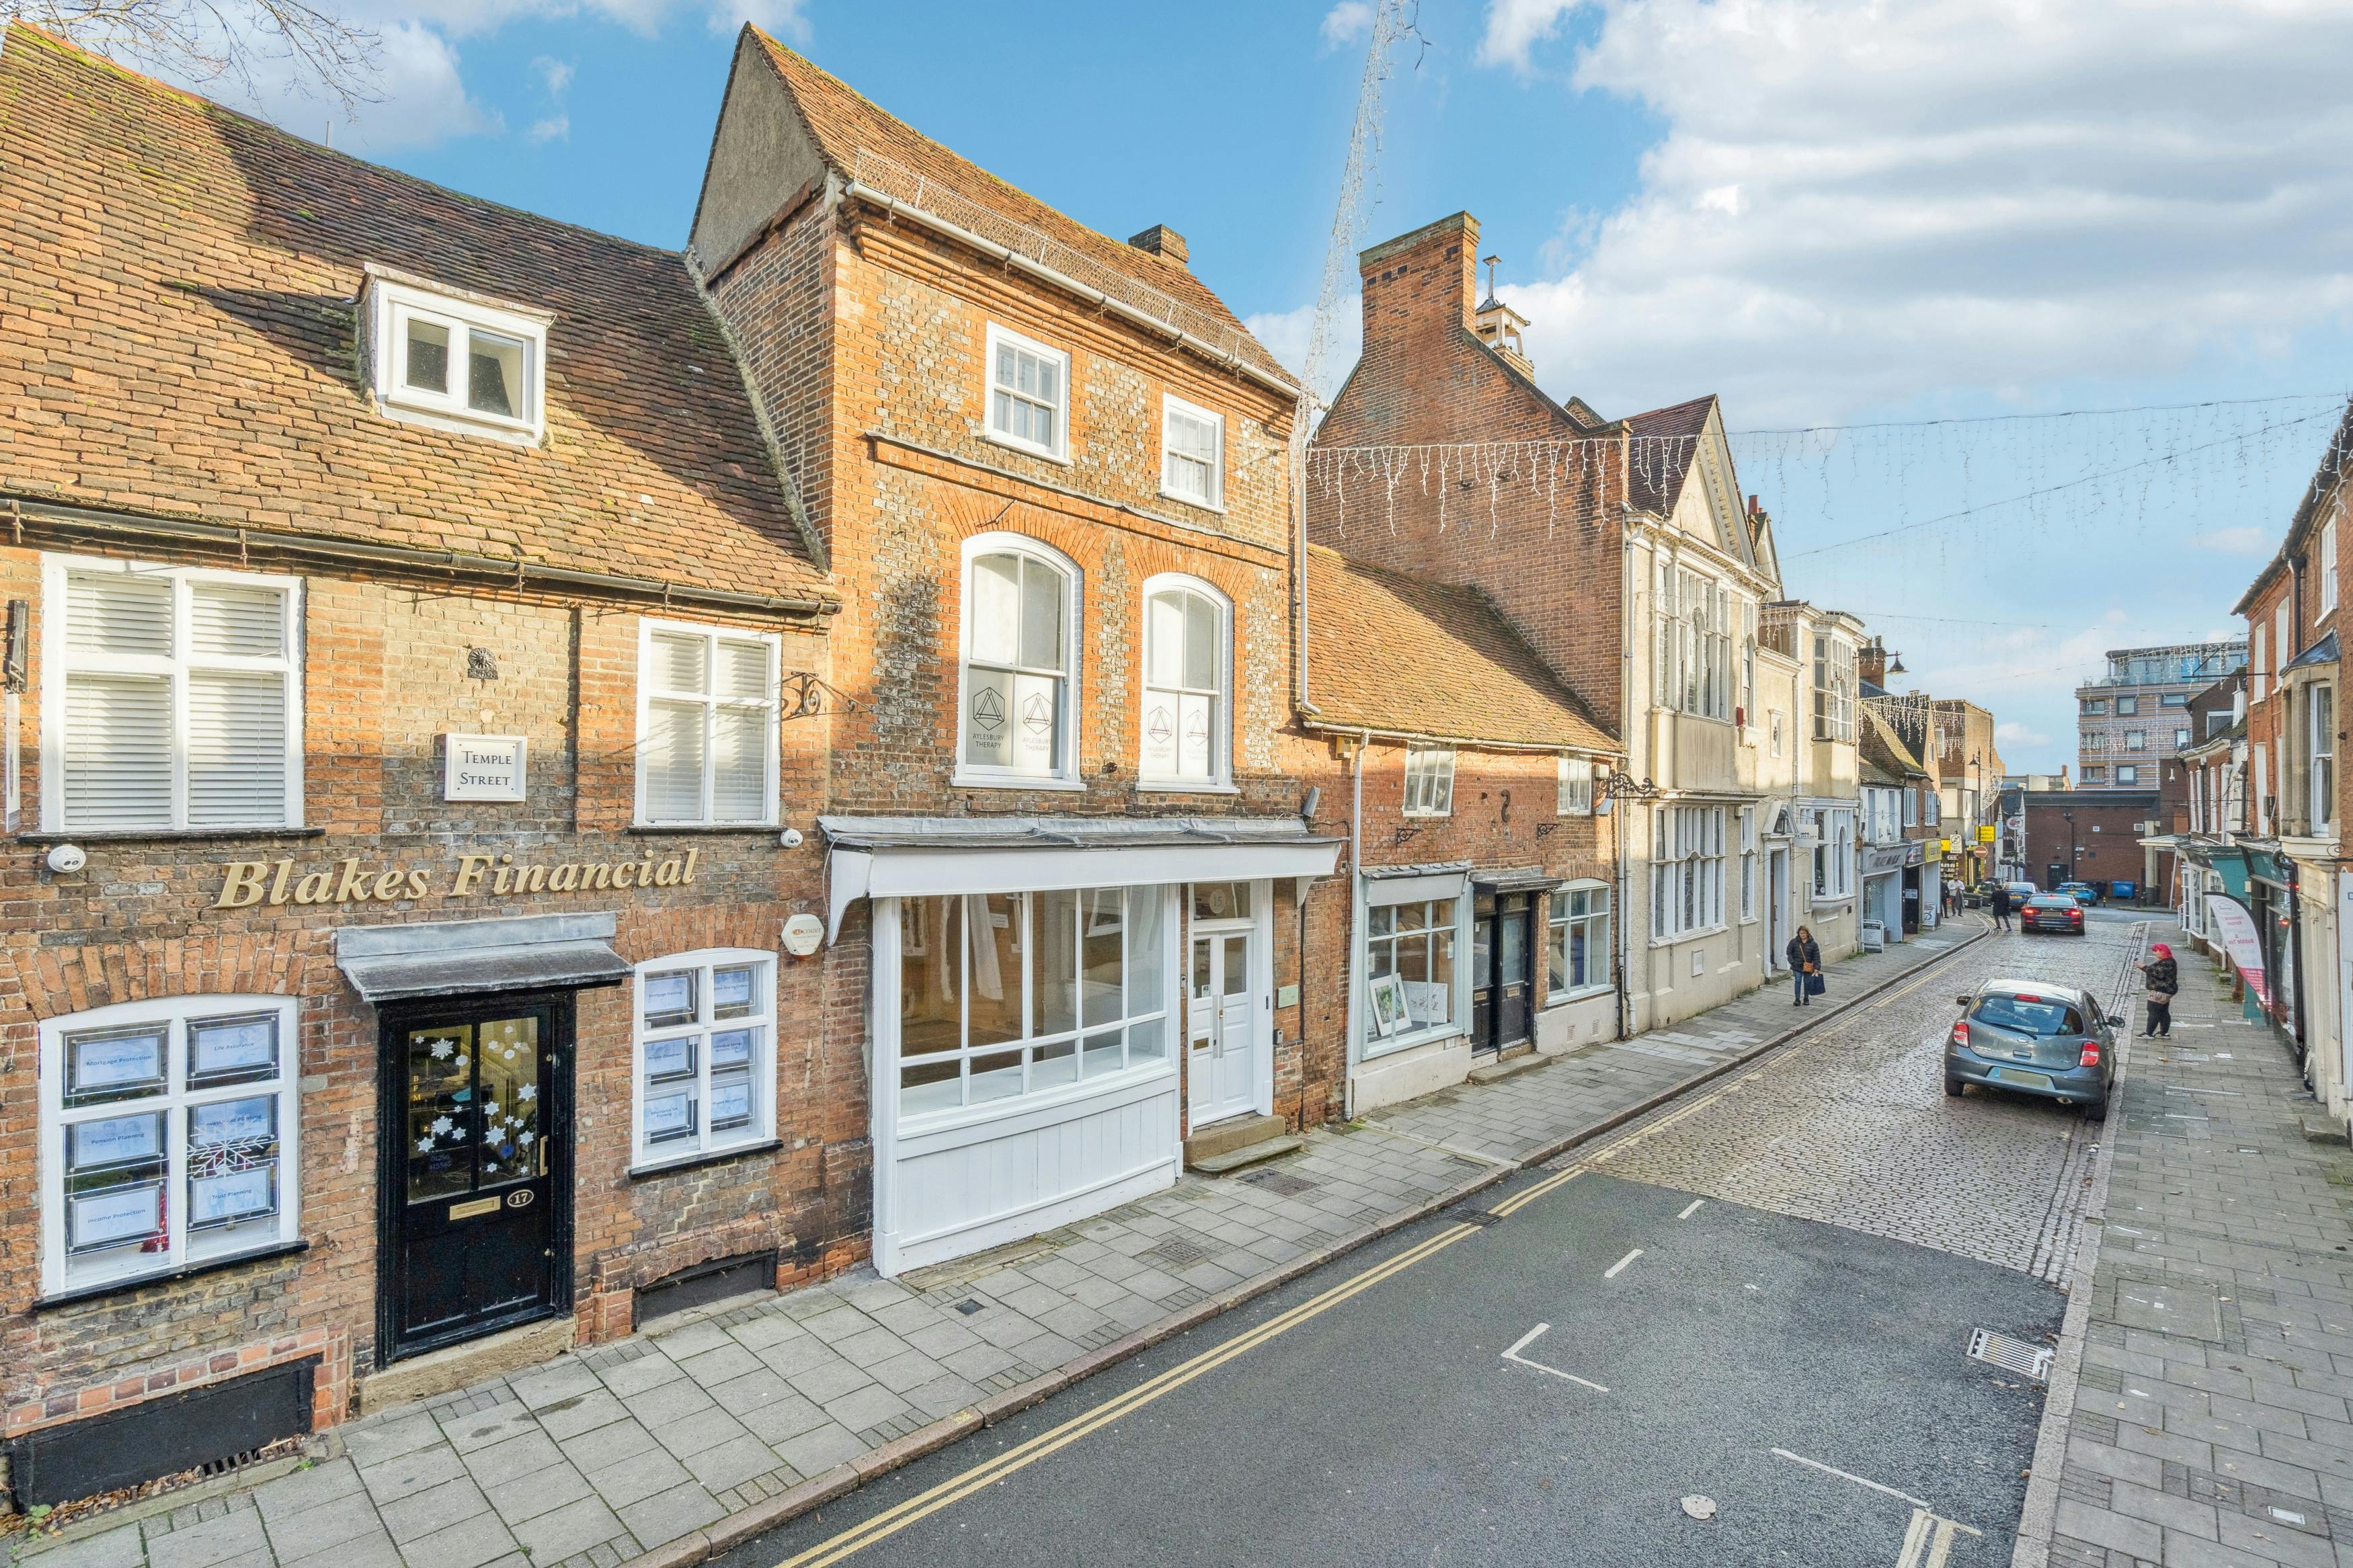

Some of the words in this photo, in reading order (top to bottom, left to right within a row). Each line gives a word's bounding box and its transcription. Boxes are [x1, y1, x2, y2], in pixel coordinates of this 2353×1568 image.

[214, 857, 431, 908] Blakes
[448, 848, 699, 897] Financial
[1213, 896, 1222, 907] 15
[119, 1055, 151, 1063] Protection
[91, 1137, 116, 1145] Pension
[117, 1132, 145, 1141] Planning
[227, 1188, 252, 1198] Planning
[514, 1194, 528, 1204] 17
[87, 1215, 112, 1224] Income
[113, 1209, 146, 1219] Protection
